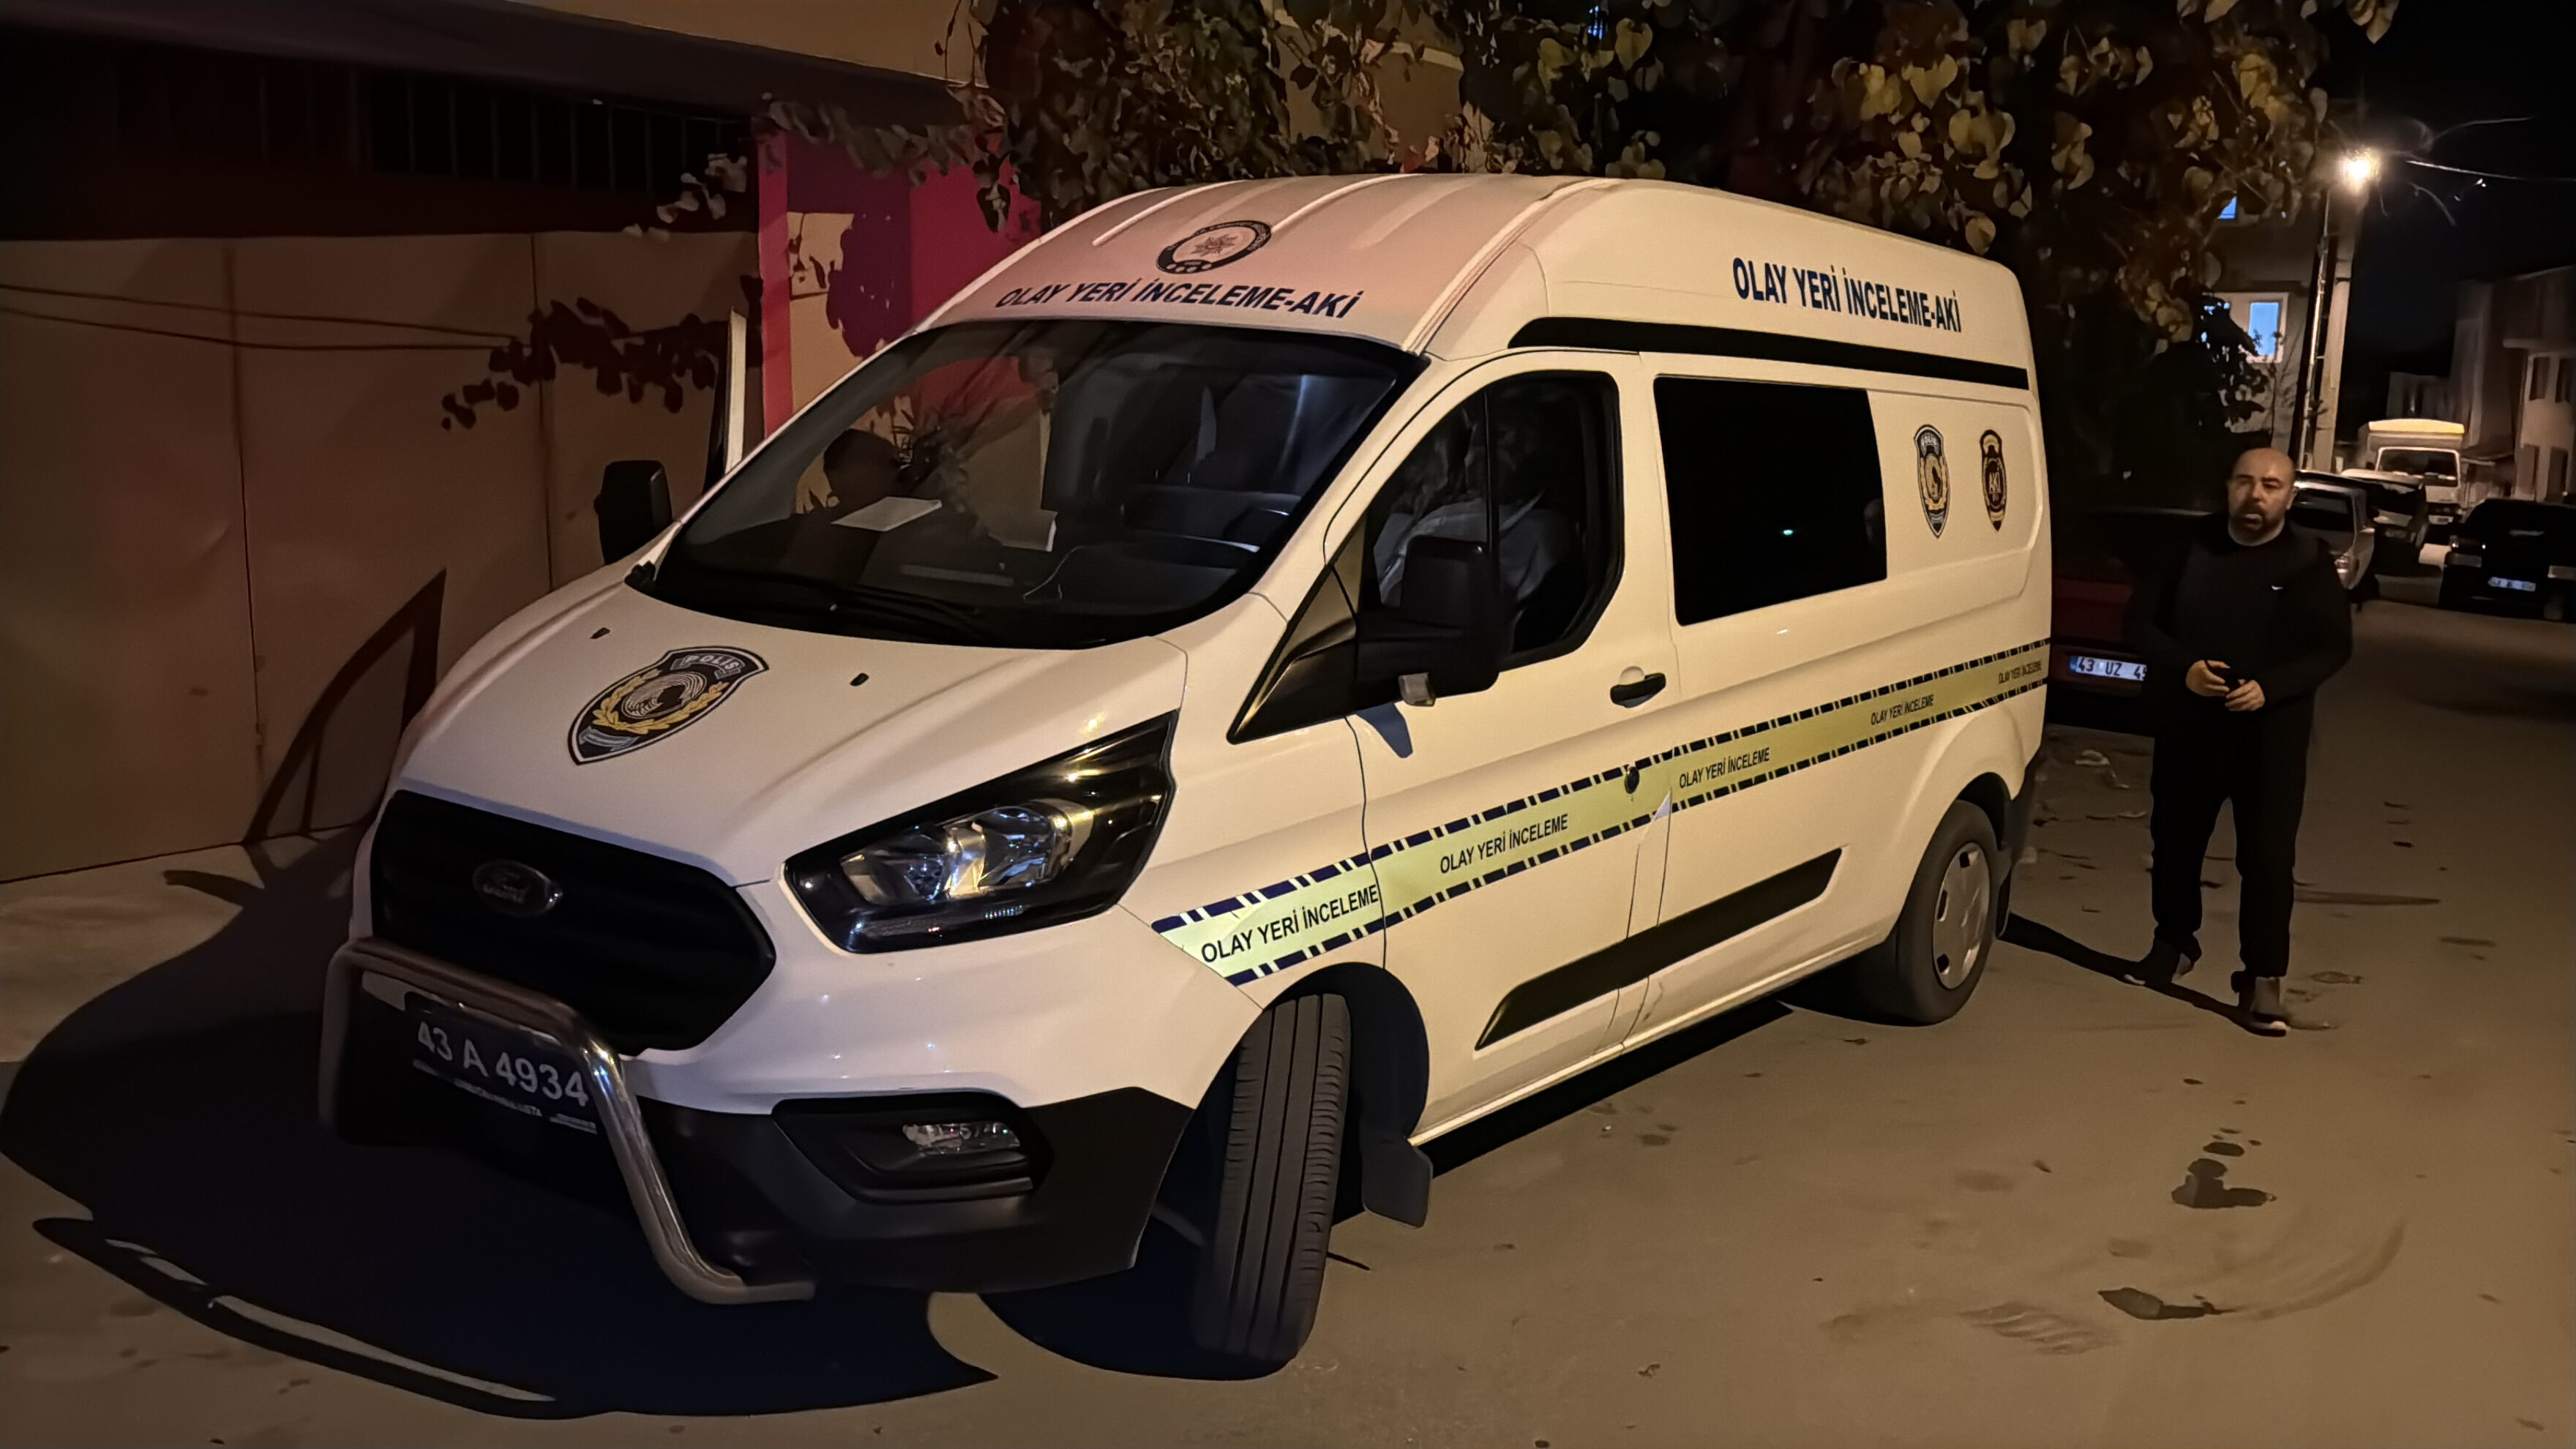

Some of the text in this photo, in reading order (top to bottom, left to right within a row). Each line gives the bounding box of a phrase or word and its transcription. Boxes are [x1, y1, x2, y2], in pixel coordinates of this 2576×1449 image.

[995, 277, 1364, 318] OLAY YERİ İNCELEME-AKİ
[1732, 257, 1962, 333] OLAY YERİ İNCELEME-AKİ
[2078, 656, 2094, 672] 43
[2105, 661, 2122, 676] UZ
[1679, 746, 1770, 788] OLAY YERİ İNCELEME
[1440, 813, 1568, 875] OLAY YERİ İNCELEME
[1201, 884, 1379, 963] OLAY YERİ İNCELEME
[418, 1021, 453, 1061] 43
[463, 1038, 489, 1078] A
[495, 1052, 589, 1107] 4934
